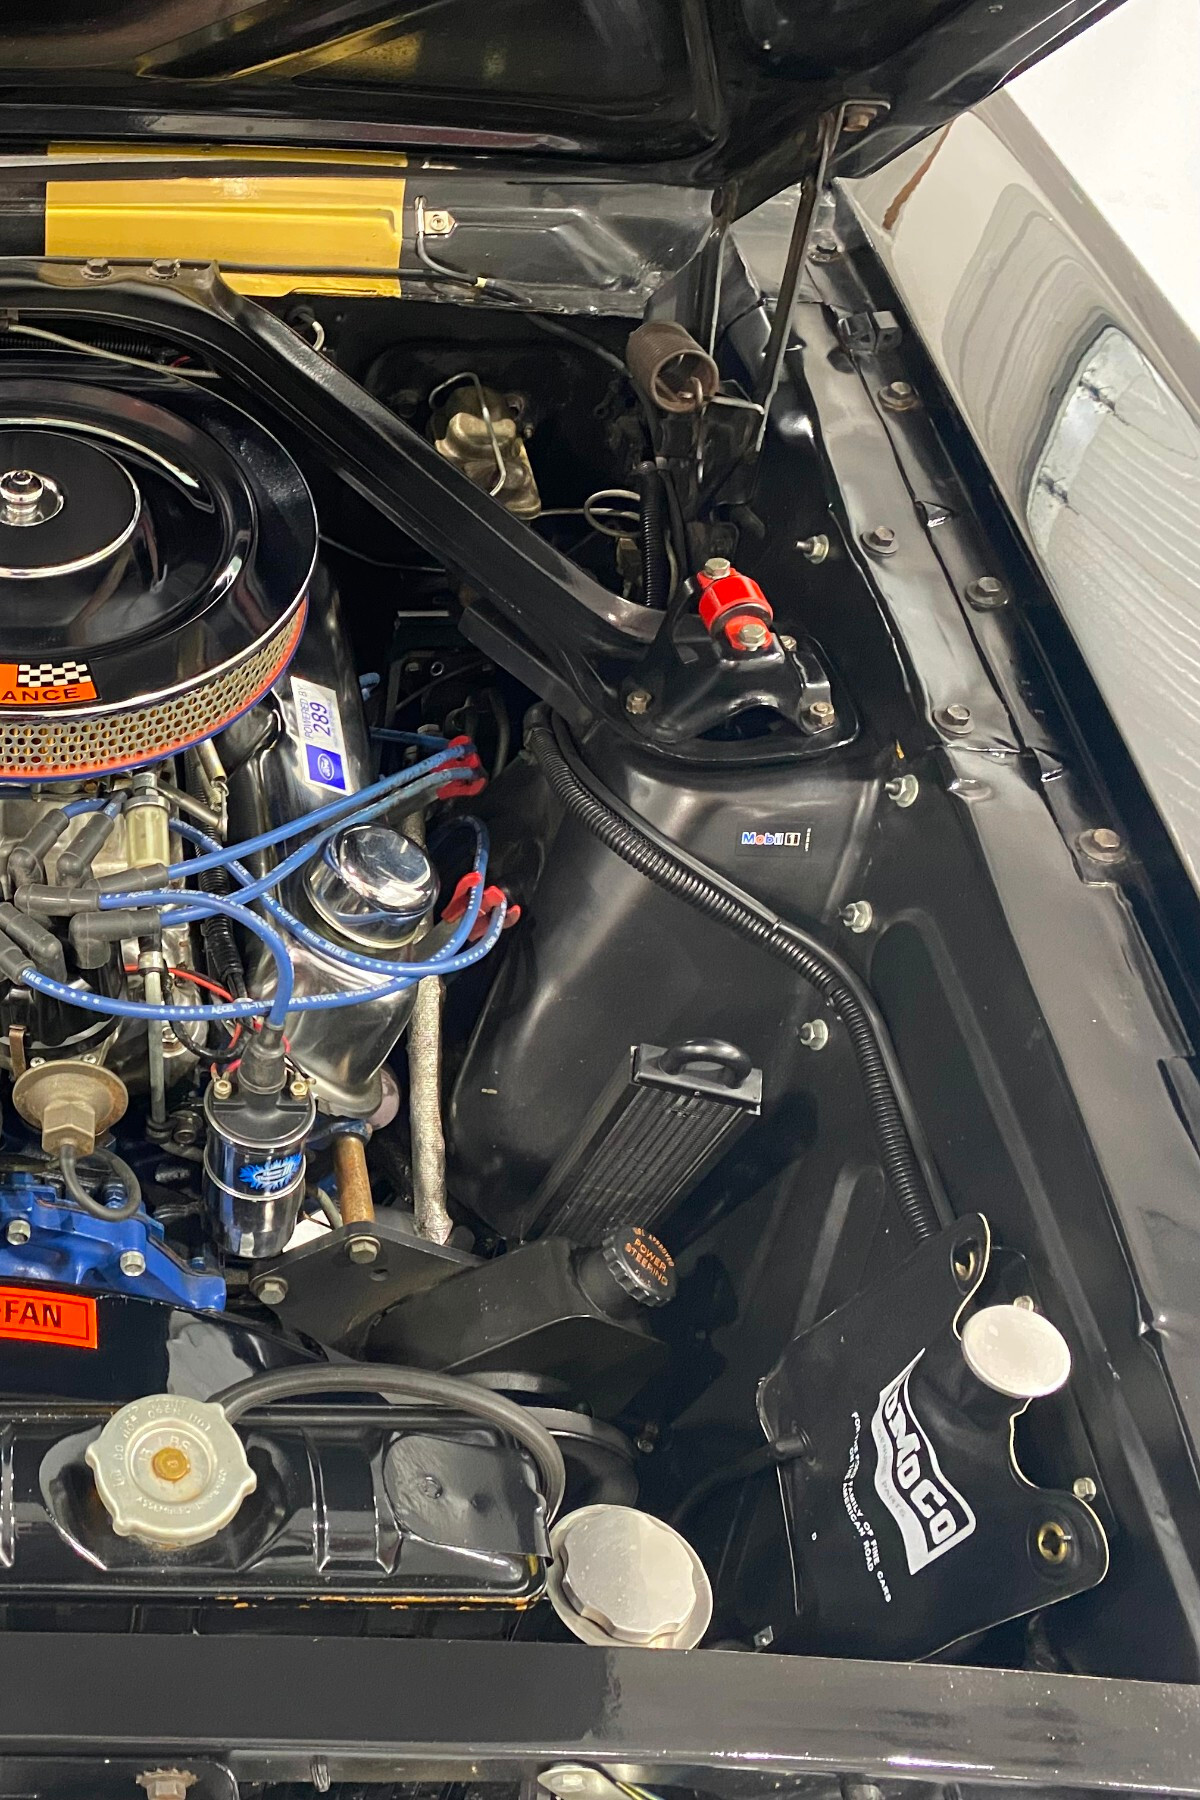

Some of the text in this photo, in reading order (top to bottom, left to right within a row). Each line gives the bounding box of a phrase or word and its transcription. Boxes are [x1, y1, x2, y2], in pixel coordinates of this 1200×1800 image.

[299, 700, 314, 739] POWERED
[309, 701, 331, 737] 289
[741, 832, 785, 846] Mobil
[241, 1000, 275, 1011] HI-TEM
[288, 996, 309, 1007] UPER
[310, 993, 338, 1003] STOCK
[625, 1242, 669, 1286] STEERING
[634, 1238, 667, 1272] POWER
[851, 1411, 861, 1434] FOR
[844, 1481, 864, 1517] FAMILY
[881, 1480, 906, 1519] PARTS
[842, 1482, 866, 1537] AMERICAN
[862, 1540, 875, 1572] ROAD
[862, 1521, 874, 1537] OF
[869, 1540, 881, 1566] FINE
[876, 1571, 892, 1603] CARS
